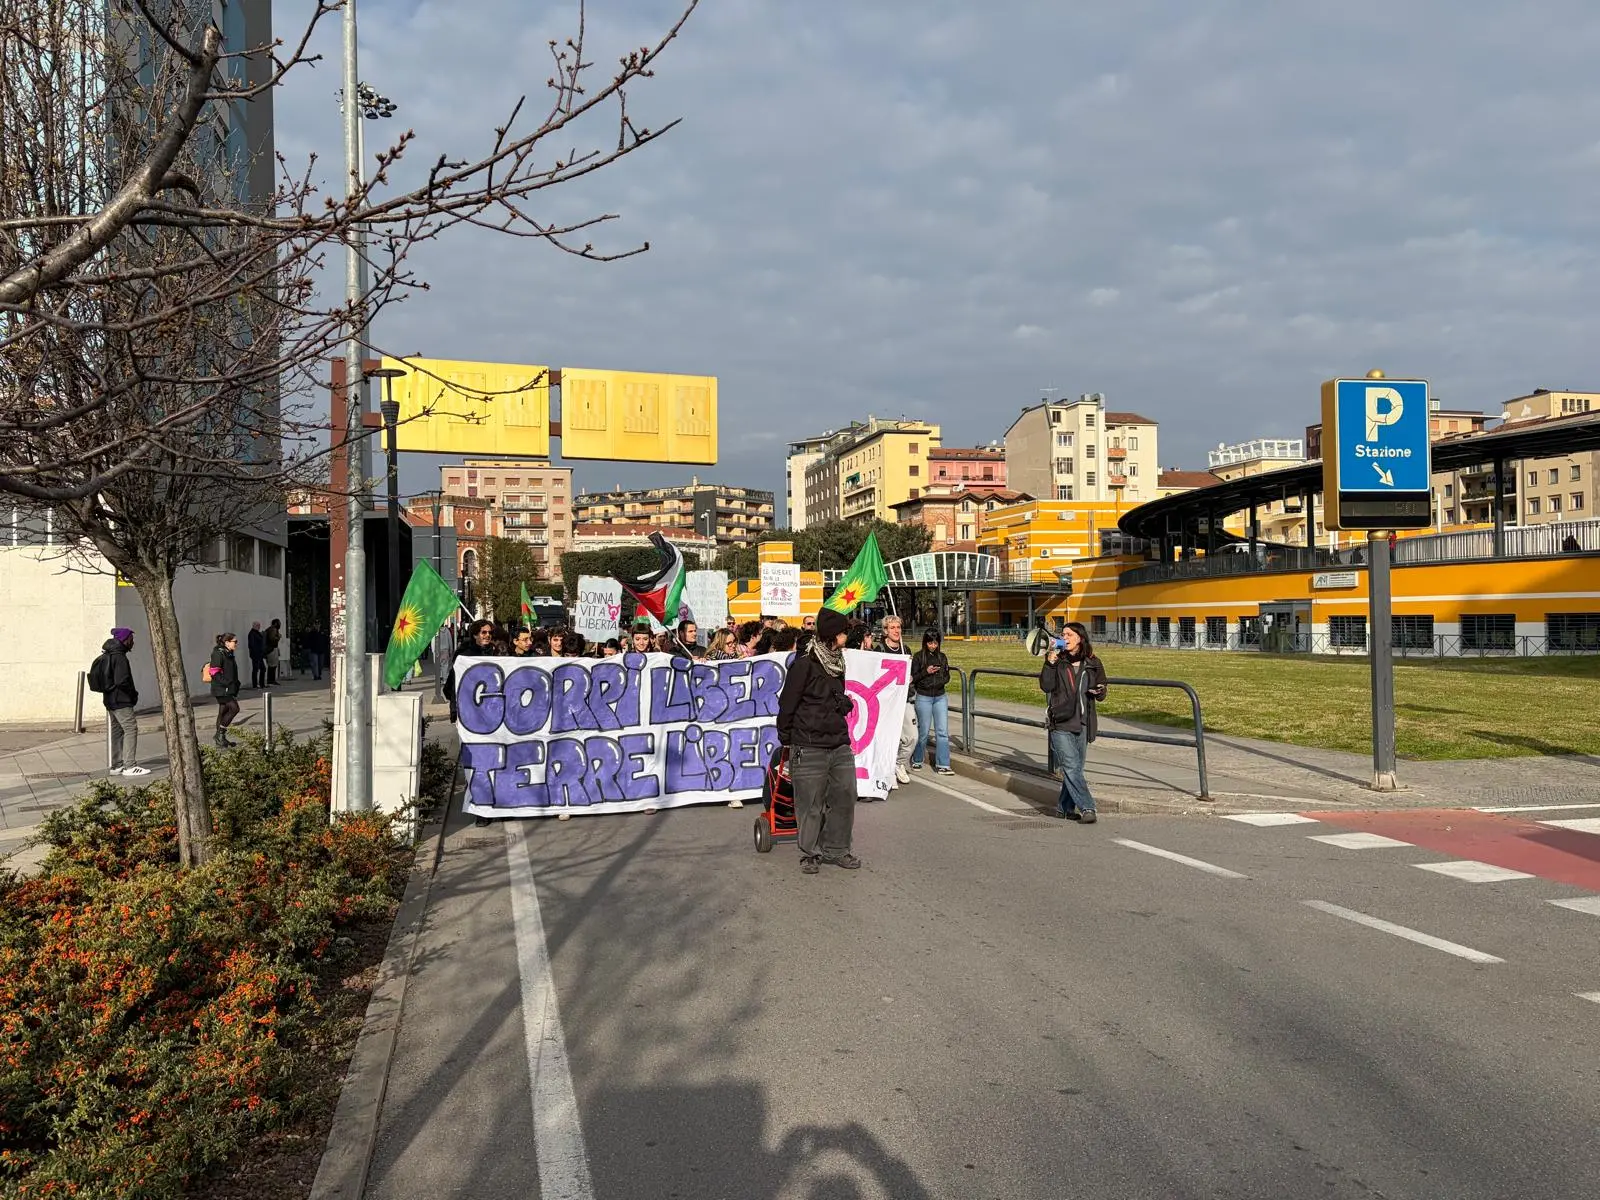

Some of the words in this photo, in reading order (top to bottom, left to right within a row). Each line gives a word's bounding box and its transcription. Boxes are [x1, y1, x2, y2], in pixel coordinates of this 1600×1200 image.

[1365, 387, 1404, 442] P
[1355, 444, 1412, 458] Stazione
[580, 591, 613, 605] DONNA
[580, 604, 606, 617] VITA
[461, 733, 660, 808] TERRE
